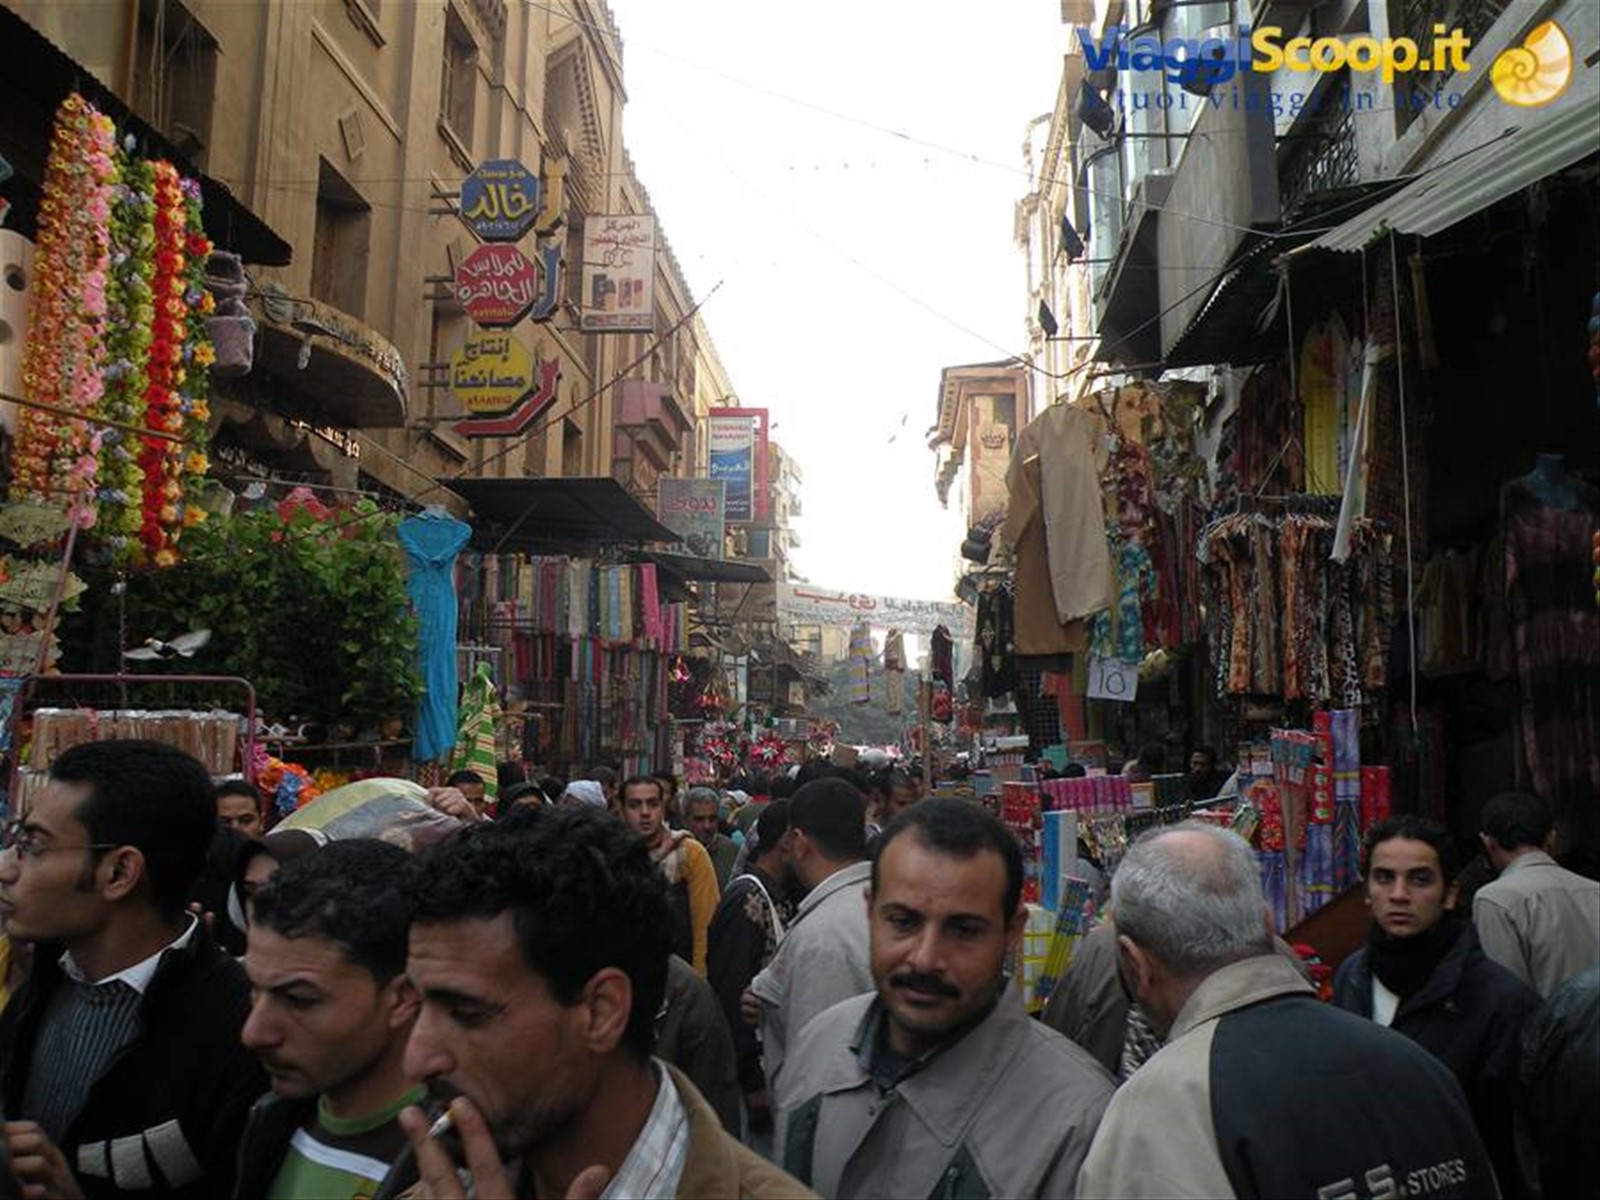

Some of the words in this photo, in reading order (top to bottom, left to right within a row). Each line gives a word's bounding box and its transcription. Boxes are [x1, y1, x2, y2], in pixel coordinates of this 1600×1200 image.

[464, 183, 534, 220] خالد
[460, 252, 525, 277] للملابس
[1099, 668, 1126, 695] 10
[1407, 1158, 1467, 1195] STORES
